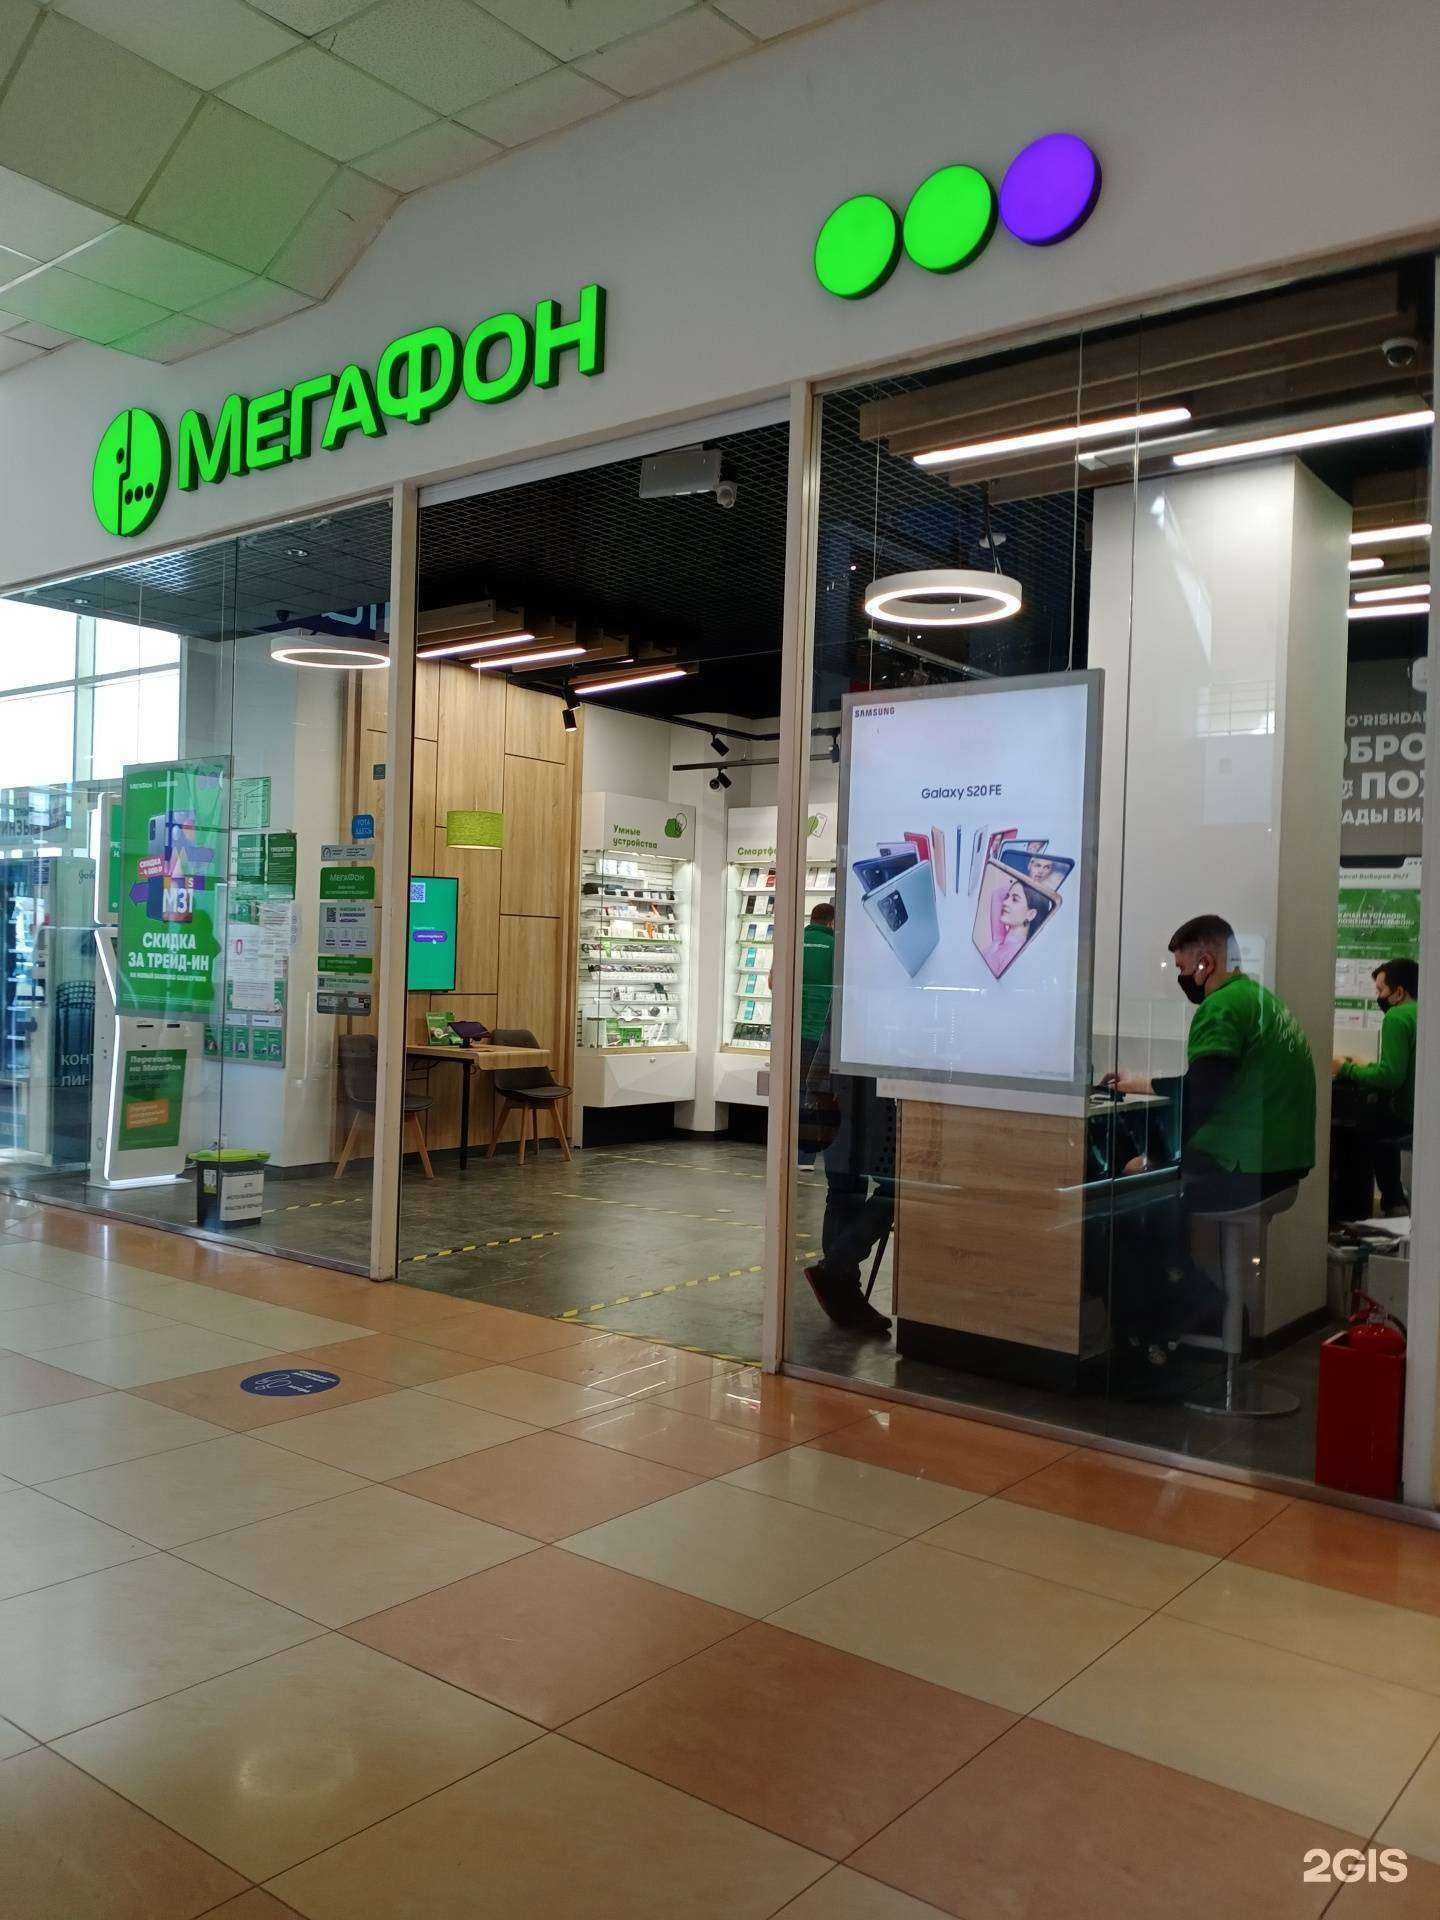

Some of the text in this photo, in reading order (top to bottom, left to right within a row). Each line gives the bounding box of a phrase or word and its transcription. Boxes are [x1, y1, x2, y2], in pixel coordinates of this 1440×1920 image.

[178, 284, 607, 492] МЕГАФОН
[854, 707, 895, 718] SAMSUNG
[1346, 711, 1427, 727] O'RISHDA
[1345, 732, 1427, 763] БРО
[921, 784, 1002, 800] Galaxy S20 FE
[1341, 807, 1425, 826] АДЫ ВИ
[613, 824, 641, 836] Умные
[613, 838, 658, 849] устройства
[142, 932, 196, 951] СКИДКА
[128, 950, 209, 972] ЗА ТРЕЙД-ИН
